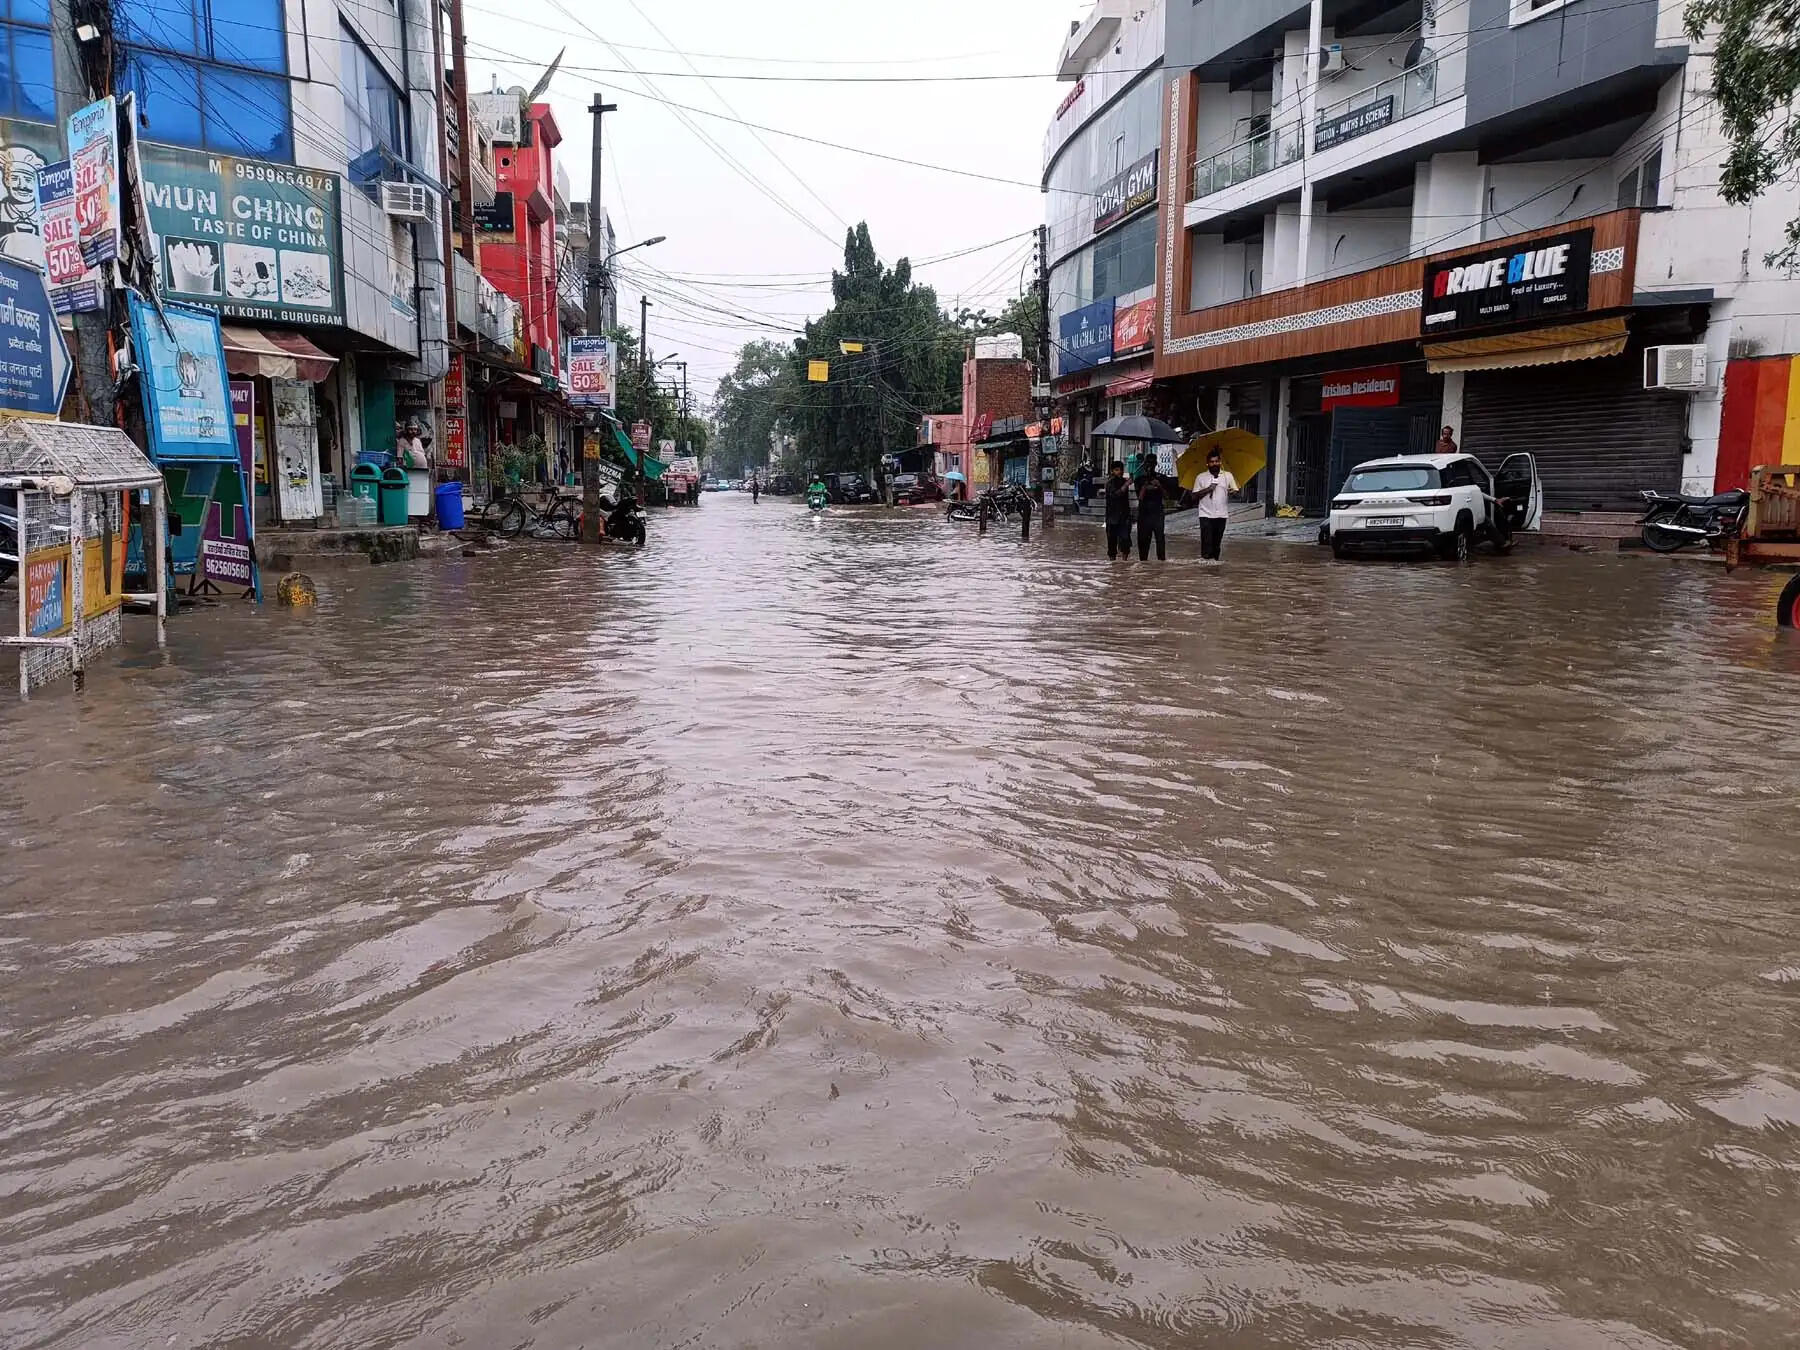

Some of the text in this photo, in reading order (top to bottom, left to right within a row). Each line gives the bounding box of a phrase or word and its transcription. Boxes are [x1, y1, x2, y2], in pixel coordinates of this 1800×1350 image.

[1365, 104, 1390, 124] SCIENCE
[208, 159, 222, 174] M
[38, 167, 72, 188] Empor
[1094, 161, 1153, 219] ROYAL GYM
[145, 181, 324, 230] MUN CHING
[43, 217, 73, 243] SALE
[192, 216, 328, 248] TASTE OF CHINA
[50, 245, 80, 277] 50%
[1433, 243, 1571, 298] BRAVE BLUE
[1511, 287, 1524, 296] Feel
[1526, 285, 1533, 293] of
[1543, 294, 1567, 304] SURPLUS
[223, 305, 236, 316] KI
[281, 311, 343, 326] GURUGRAM
[572, 337, 605, 347] Emporio
[1098, 323, 1112, 343] ERA
[571, 362, 596, 372] SALE
[573, 374, 599, 388] 50%
[1322, 378, 1395, 398] Krishna Residency
[29, 560, 59, 581] HARYANA
[206, 558, 250, 579] 9625605680
[30, 580, 56, 604] POLICE
